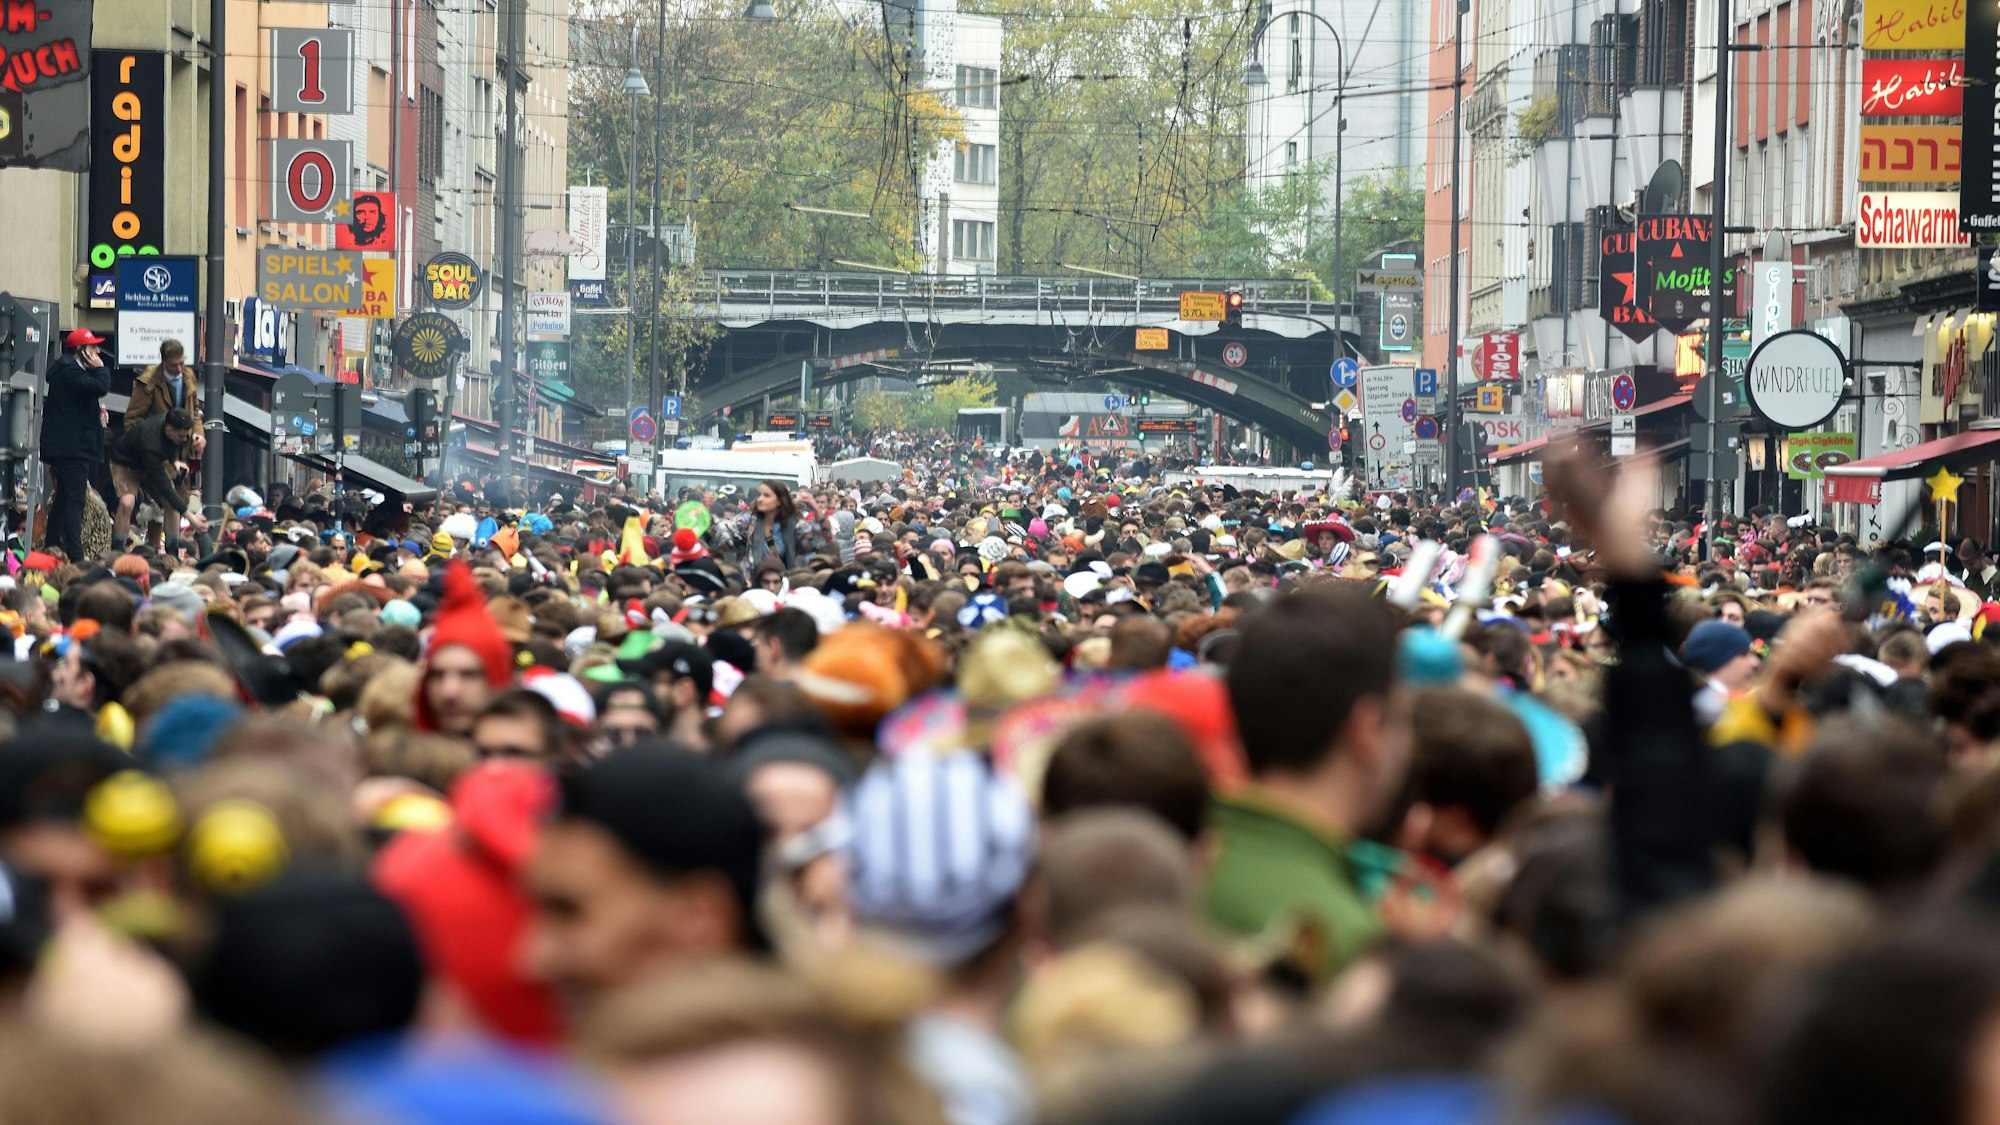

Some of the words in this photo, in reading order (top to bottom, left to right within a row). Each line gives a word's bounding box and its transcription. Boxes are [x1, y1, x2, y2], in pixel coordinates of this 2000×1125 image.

[1862, 62, 1961, 114] Habib
[111, 56, 141, 240] radio
[265, 253, 336, 276] SPIEL
[426, 264, 478, 283] SOUL
[580, 284, 603, 294] Gaffel
[1655, 267, 1734, 292] Mojits
[264, 281, 350, 304] SALON
[362, 291, 388, 303] BA
[432, 281, 471, 300] BAR
[346, 304, 382, 316] BAR
[532, 296, 565, 308] GYROS
[1490, 334, 1514, 380] KIOSK
